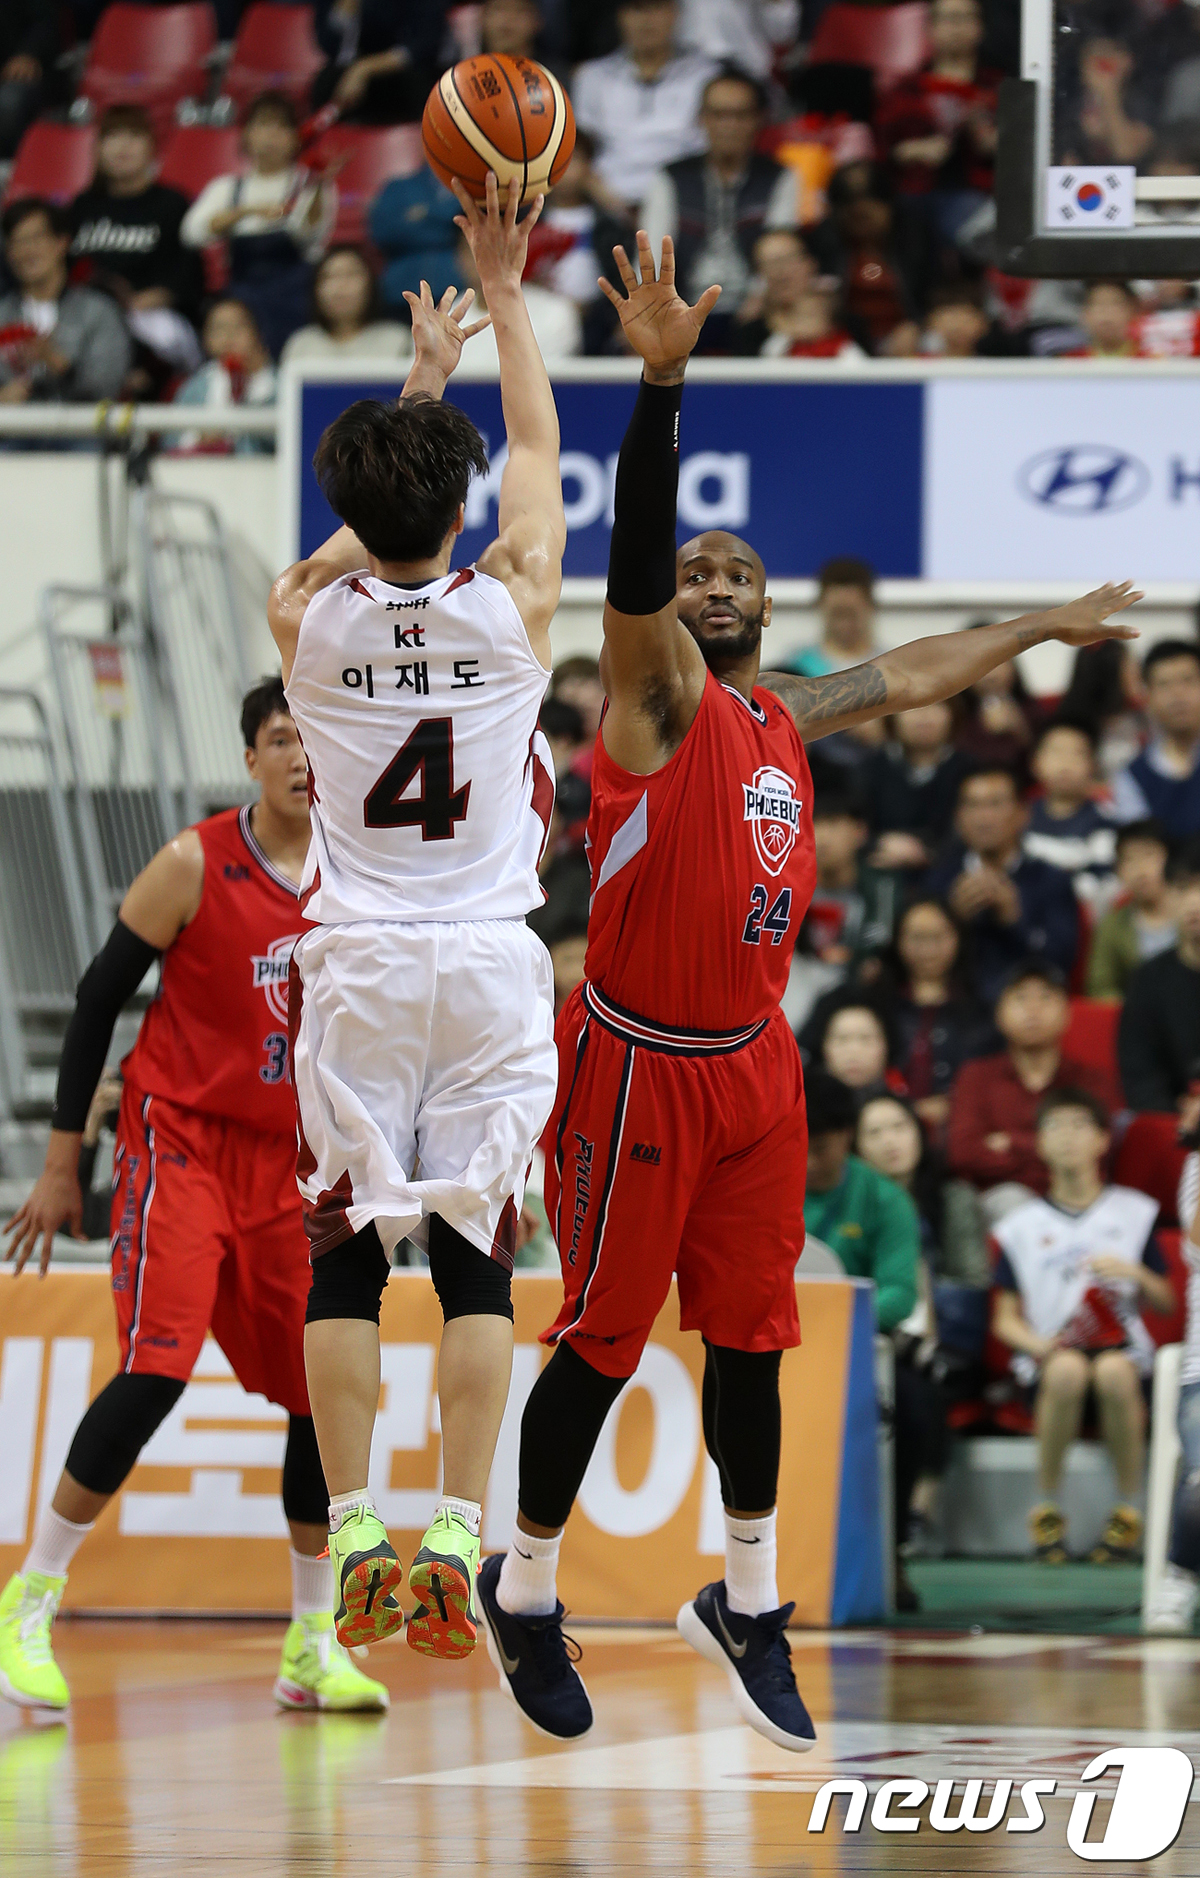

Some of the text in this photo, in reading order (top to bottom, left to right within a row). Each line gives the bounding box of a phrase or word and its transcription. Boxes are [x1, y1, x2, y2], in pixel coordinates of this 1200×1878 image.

[394, 623, 426, 649] kt
[363, 716, 472, 842] 4
[742, 883, 792, 946] 24
[259, 1031, 291, 1084] 3
